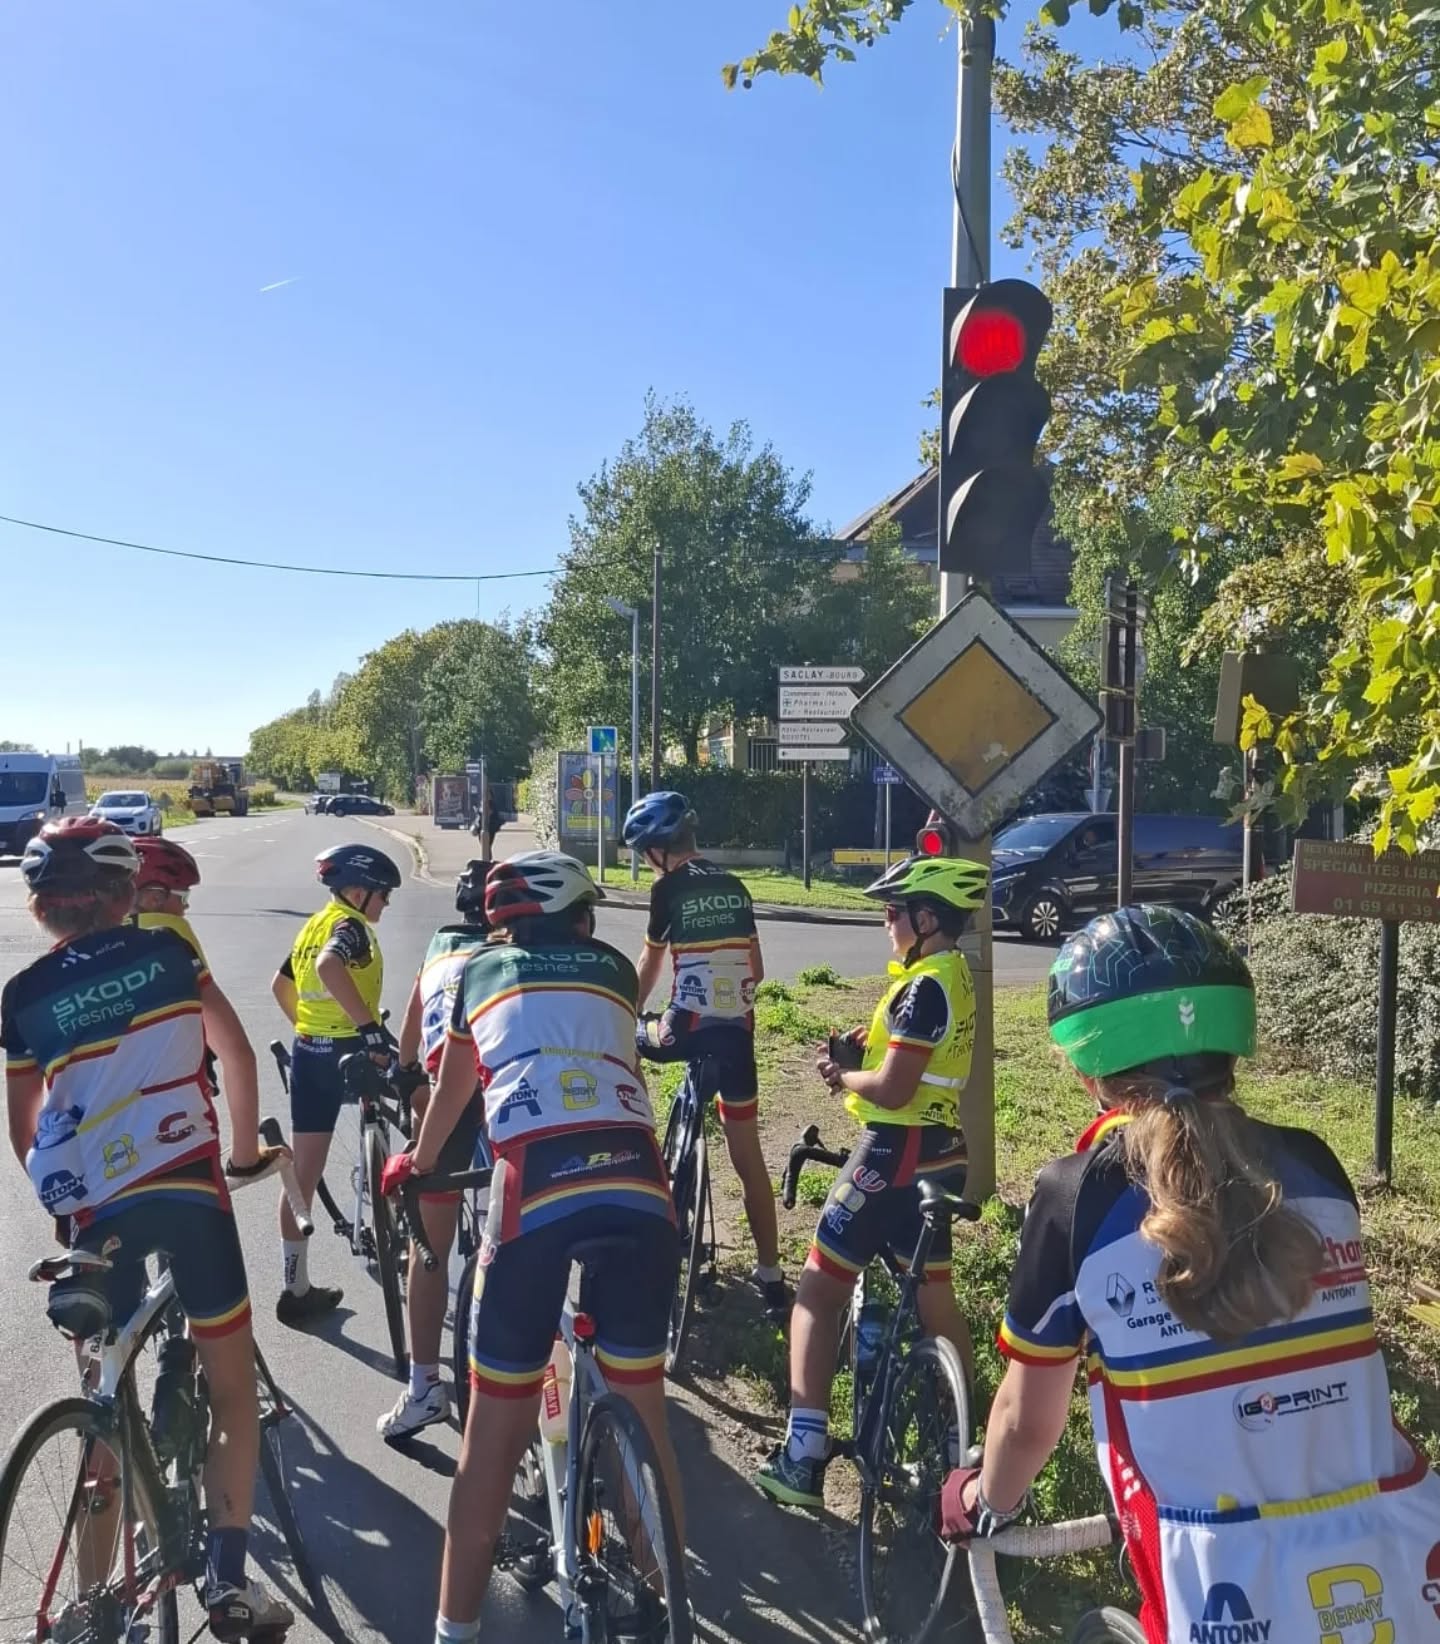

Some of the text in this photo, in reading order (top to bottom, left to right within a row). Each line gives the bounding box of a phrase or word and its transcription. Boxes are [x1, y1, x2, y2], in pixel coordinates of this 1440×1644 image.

[783, 670, 824, 679] SACLAY
[1364, 881, 1431, 898] PIZZERIA
[1333, 897, 1353, 911] 01
[1360, 900, 1380, 913] 69
[1412, 905, 1432, 917] 39
[682, 912, 736, 929] Fresnes
[501, 960, 581, 977] Fresnes
[57, 997, 136, 1036] Fresnes
[1321, 1286, 1356, 1303] ANTONY
[1127, 1311, 1172, 1329] Garage
[1318, 1596, 1383, 1631] BERNY
[1189, 1619, 1272, 1644] ANTONY
